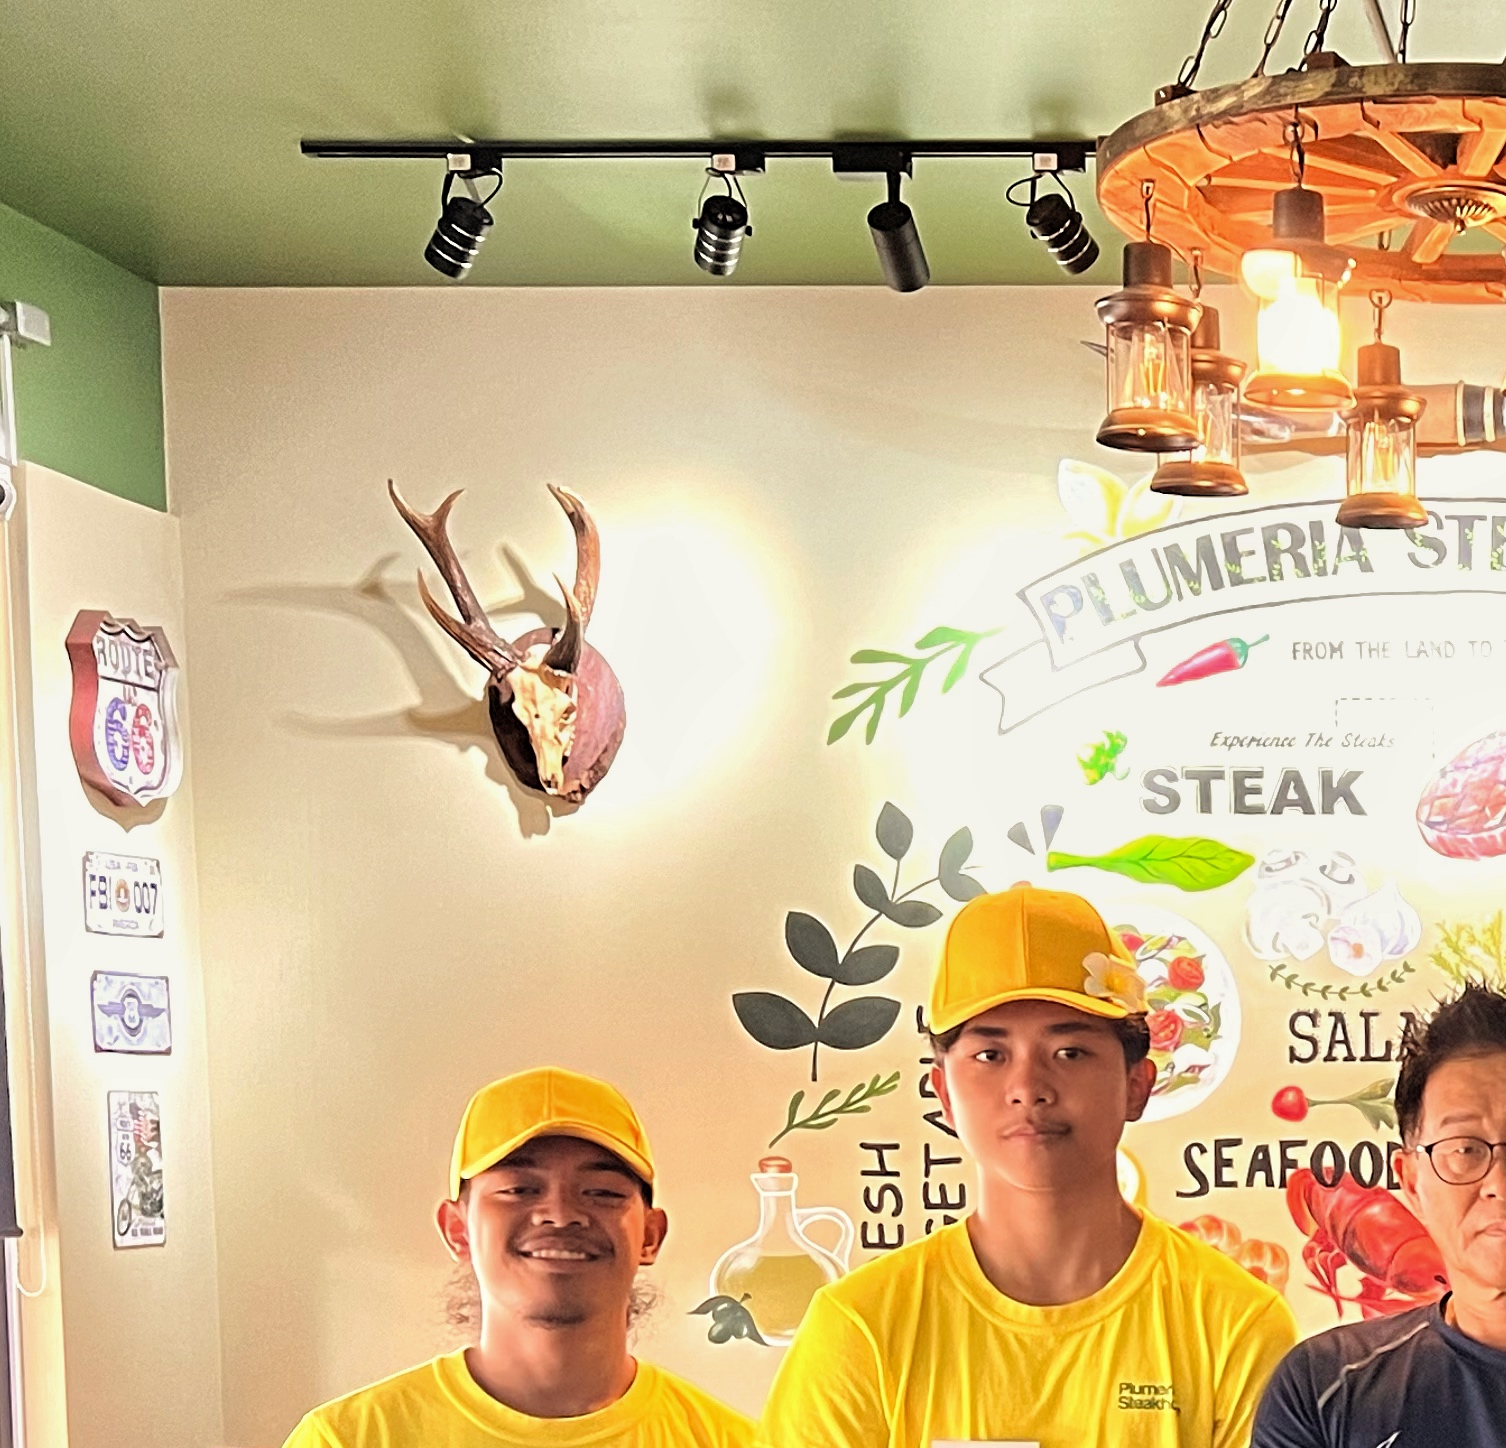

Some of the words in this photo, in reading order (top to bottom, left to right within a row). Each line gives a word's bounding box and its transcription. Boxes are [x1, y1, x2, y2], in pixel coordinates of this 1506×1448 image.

[1039, 519, 1374, 644] PLUMERIA
[1292, 640, 1344, 661] FROM
[1355, 641, 1391, 659] THE
[1405, 640, 1455, 659] LAND
[1468, 640, 1492, 658] TO
[105, 696, 155, 775] 66
[1305, 732, 1333, 748] The
[1142, 766, 1368, 816] STEAK
[133, 881, 158, 915] 007
[1288, 1011, 1422, 1063] SALA
[859, 1142, 904, 1250] ESH
[1119, 1382, 1175, 1396] Plumer
